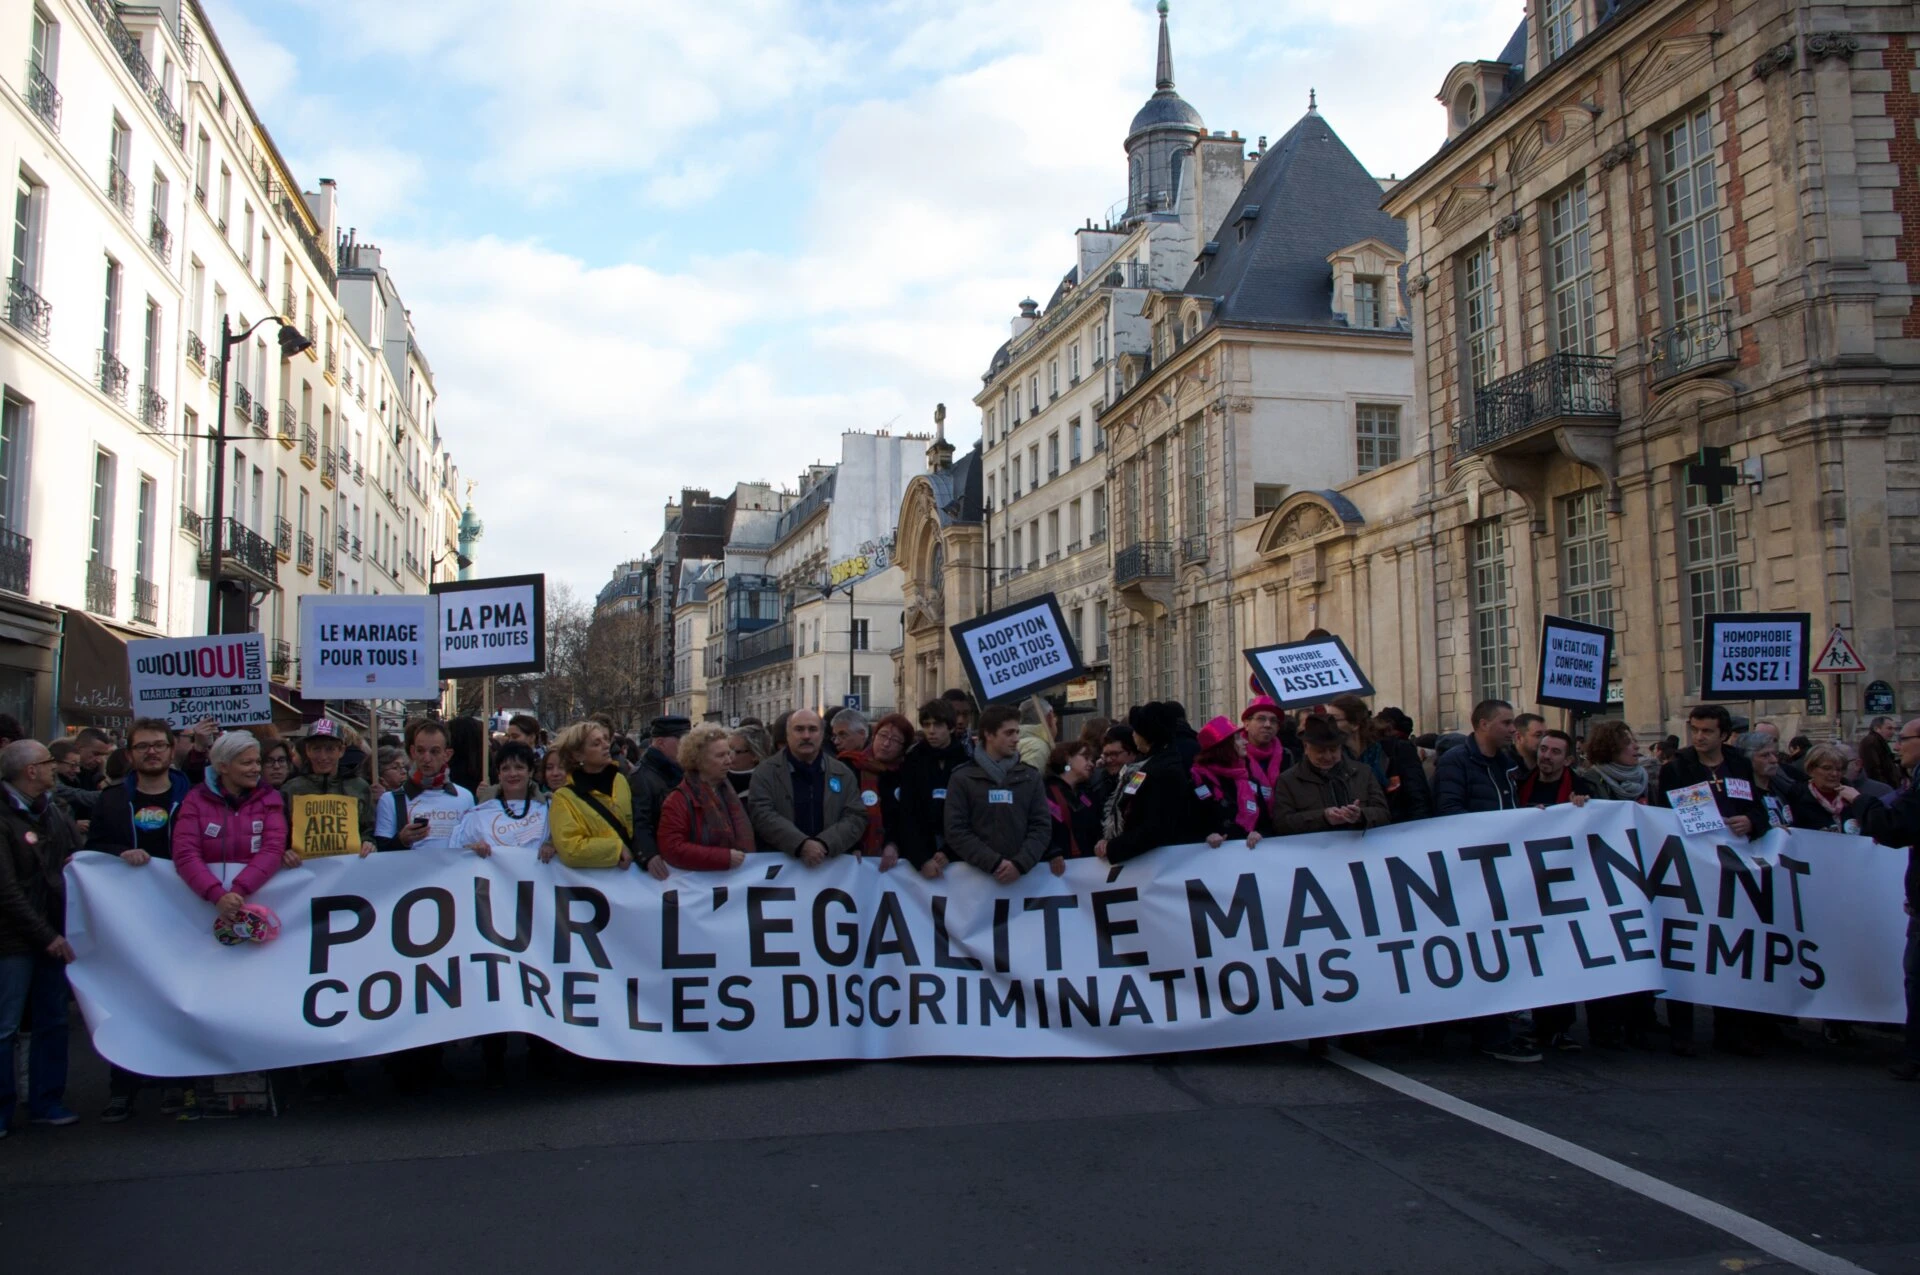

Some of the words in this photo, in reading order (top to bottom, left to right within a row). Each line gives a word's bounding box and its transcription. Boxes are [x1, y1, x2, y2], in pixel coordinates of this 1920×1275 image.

[448, 607, 473, 632] LA
[480, 602, 527, 630] PMA
[320, 624, 338, 641] LE
[344, 624, 417, 641] MARIAGE
[446, 636, 478, 651] POUR
[483, 631, 528, 649] TOUTES
[977, 615, 1048, 653] ADOPTION
[1723, 630, 1792, 643] HOMOPHOBIE
[982, 646, 1020, 670] POUR
[1019, 633, 1054, 656] TOUS
[1552, 638, 1562, 650] UN
[1563, 637, 1580, 653] ÉTAT
[1581, 643, 1598, 656] CIVIL
[1723, 646, 1791, 658] LESBOPHOBIE
[321, 649, 362, 666] POUR
[367, 649, 408, 666] TOUS
[413, 649, 417, 666] !
[1278, 650, 1323, 664] BIPHOBIE
[1555, 656, 1593, 672] CONFORME
[989, 668, 1010, 685] LES
[1012, 650, 1060, 677] COUPLES
[1273, 659, 1340, 676] TRANSPHOBIE
[1721, 661, 1779, 682] ASSEZ
[1785, 661, 1790, 681] !
[1283, 670, 1339, 693] ASSEZ
[1339, 668, 1349, 683] !
[1556, 673, 1572, 687] MON
[1573, 676, 1596, 690] GENRE
[142, 688, 181, 700] MARIAGE
[190, 686, 231, 697] ADOPTION
[241, 684, 260, 695] PMA
[305, 800, 348, 817] GOUINES
[305, 815, 348, 834] ARE
[304, 835, 348, 853] FAMILY
[309, 876, 613, 975] POUR
[662, 865, 1149, 974] L'ÉGALITÉ
[1185, 828, 1811, 959] MAINTENANT
[303, 953, 599, 1028] CONTRE
[626, 974, 756, 1032] LES
[782, 948, 1359, 1029] DISCRIMINATIONS
[1377, 924, 1544, 994] TOUT
[1660, 917, 1826, 990] EMPS
